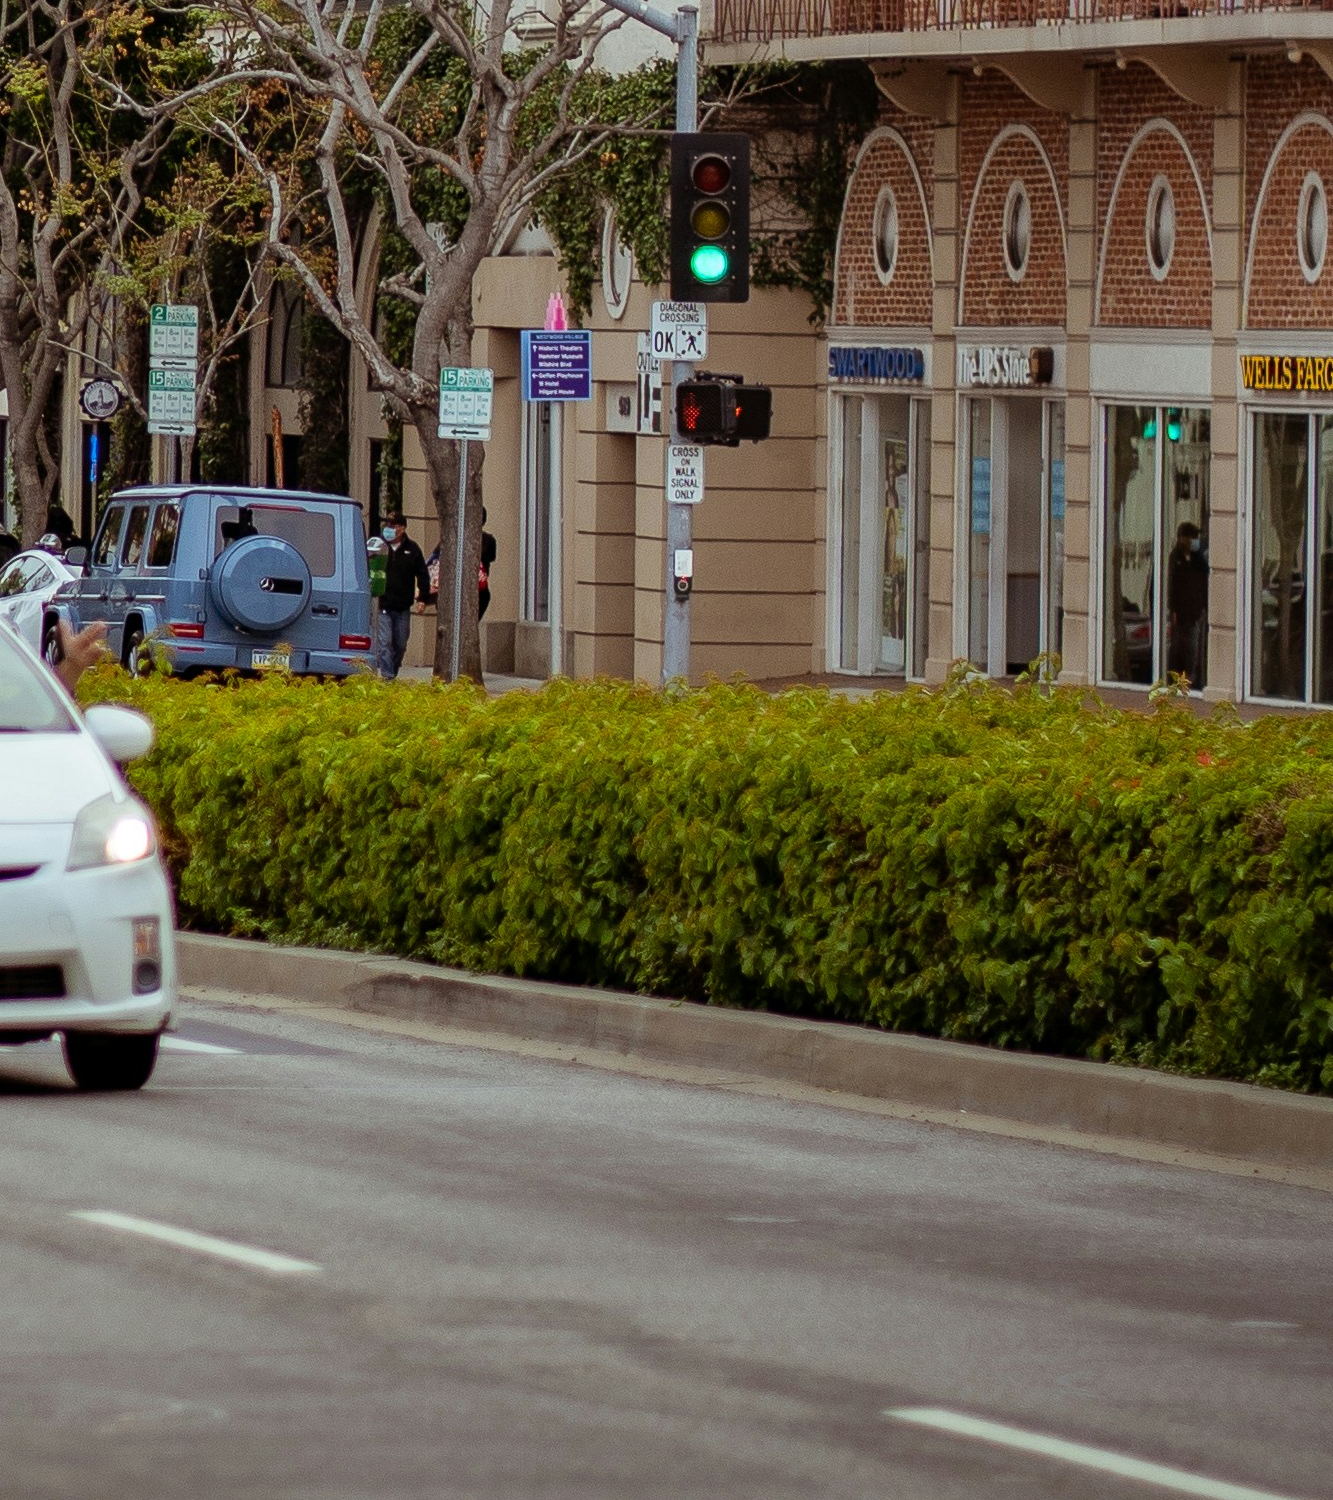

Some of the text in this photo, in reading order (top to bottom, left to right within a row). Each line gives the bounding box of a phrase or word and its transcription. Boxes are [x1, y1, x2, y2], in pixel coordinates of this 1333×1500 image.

[154, 306, 164, 320] 2
[660, 303, 699, 312] DIAGONAL
[660, 313, 700, 323] CROSSING
[654, 331, 674, 353] OK
[829, 347, 917, 380] SWARTWOOD
[960, 348, 1031, 385] The UPS Store
[152, 372, 164, 385] 15
[443, 370, 457, 385] 15
[459, 376, 490, 387] PARKING
[1240, 354, 1333, 391] WELLS FARG
[672, 447, 699, 457] CROSS
[680, 458, 690, 466] ON
[675, 467, 696, 477] WALK
[671, 478, 699, 489] SIGNAL
[675, 490, 695, 500] ONLY
